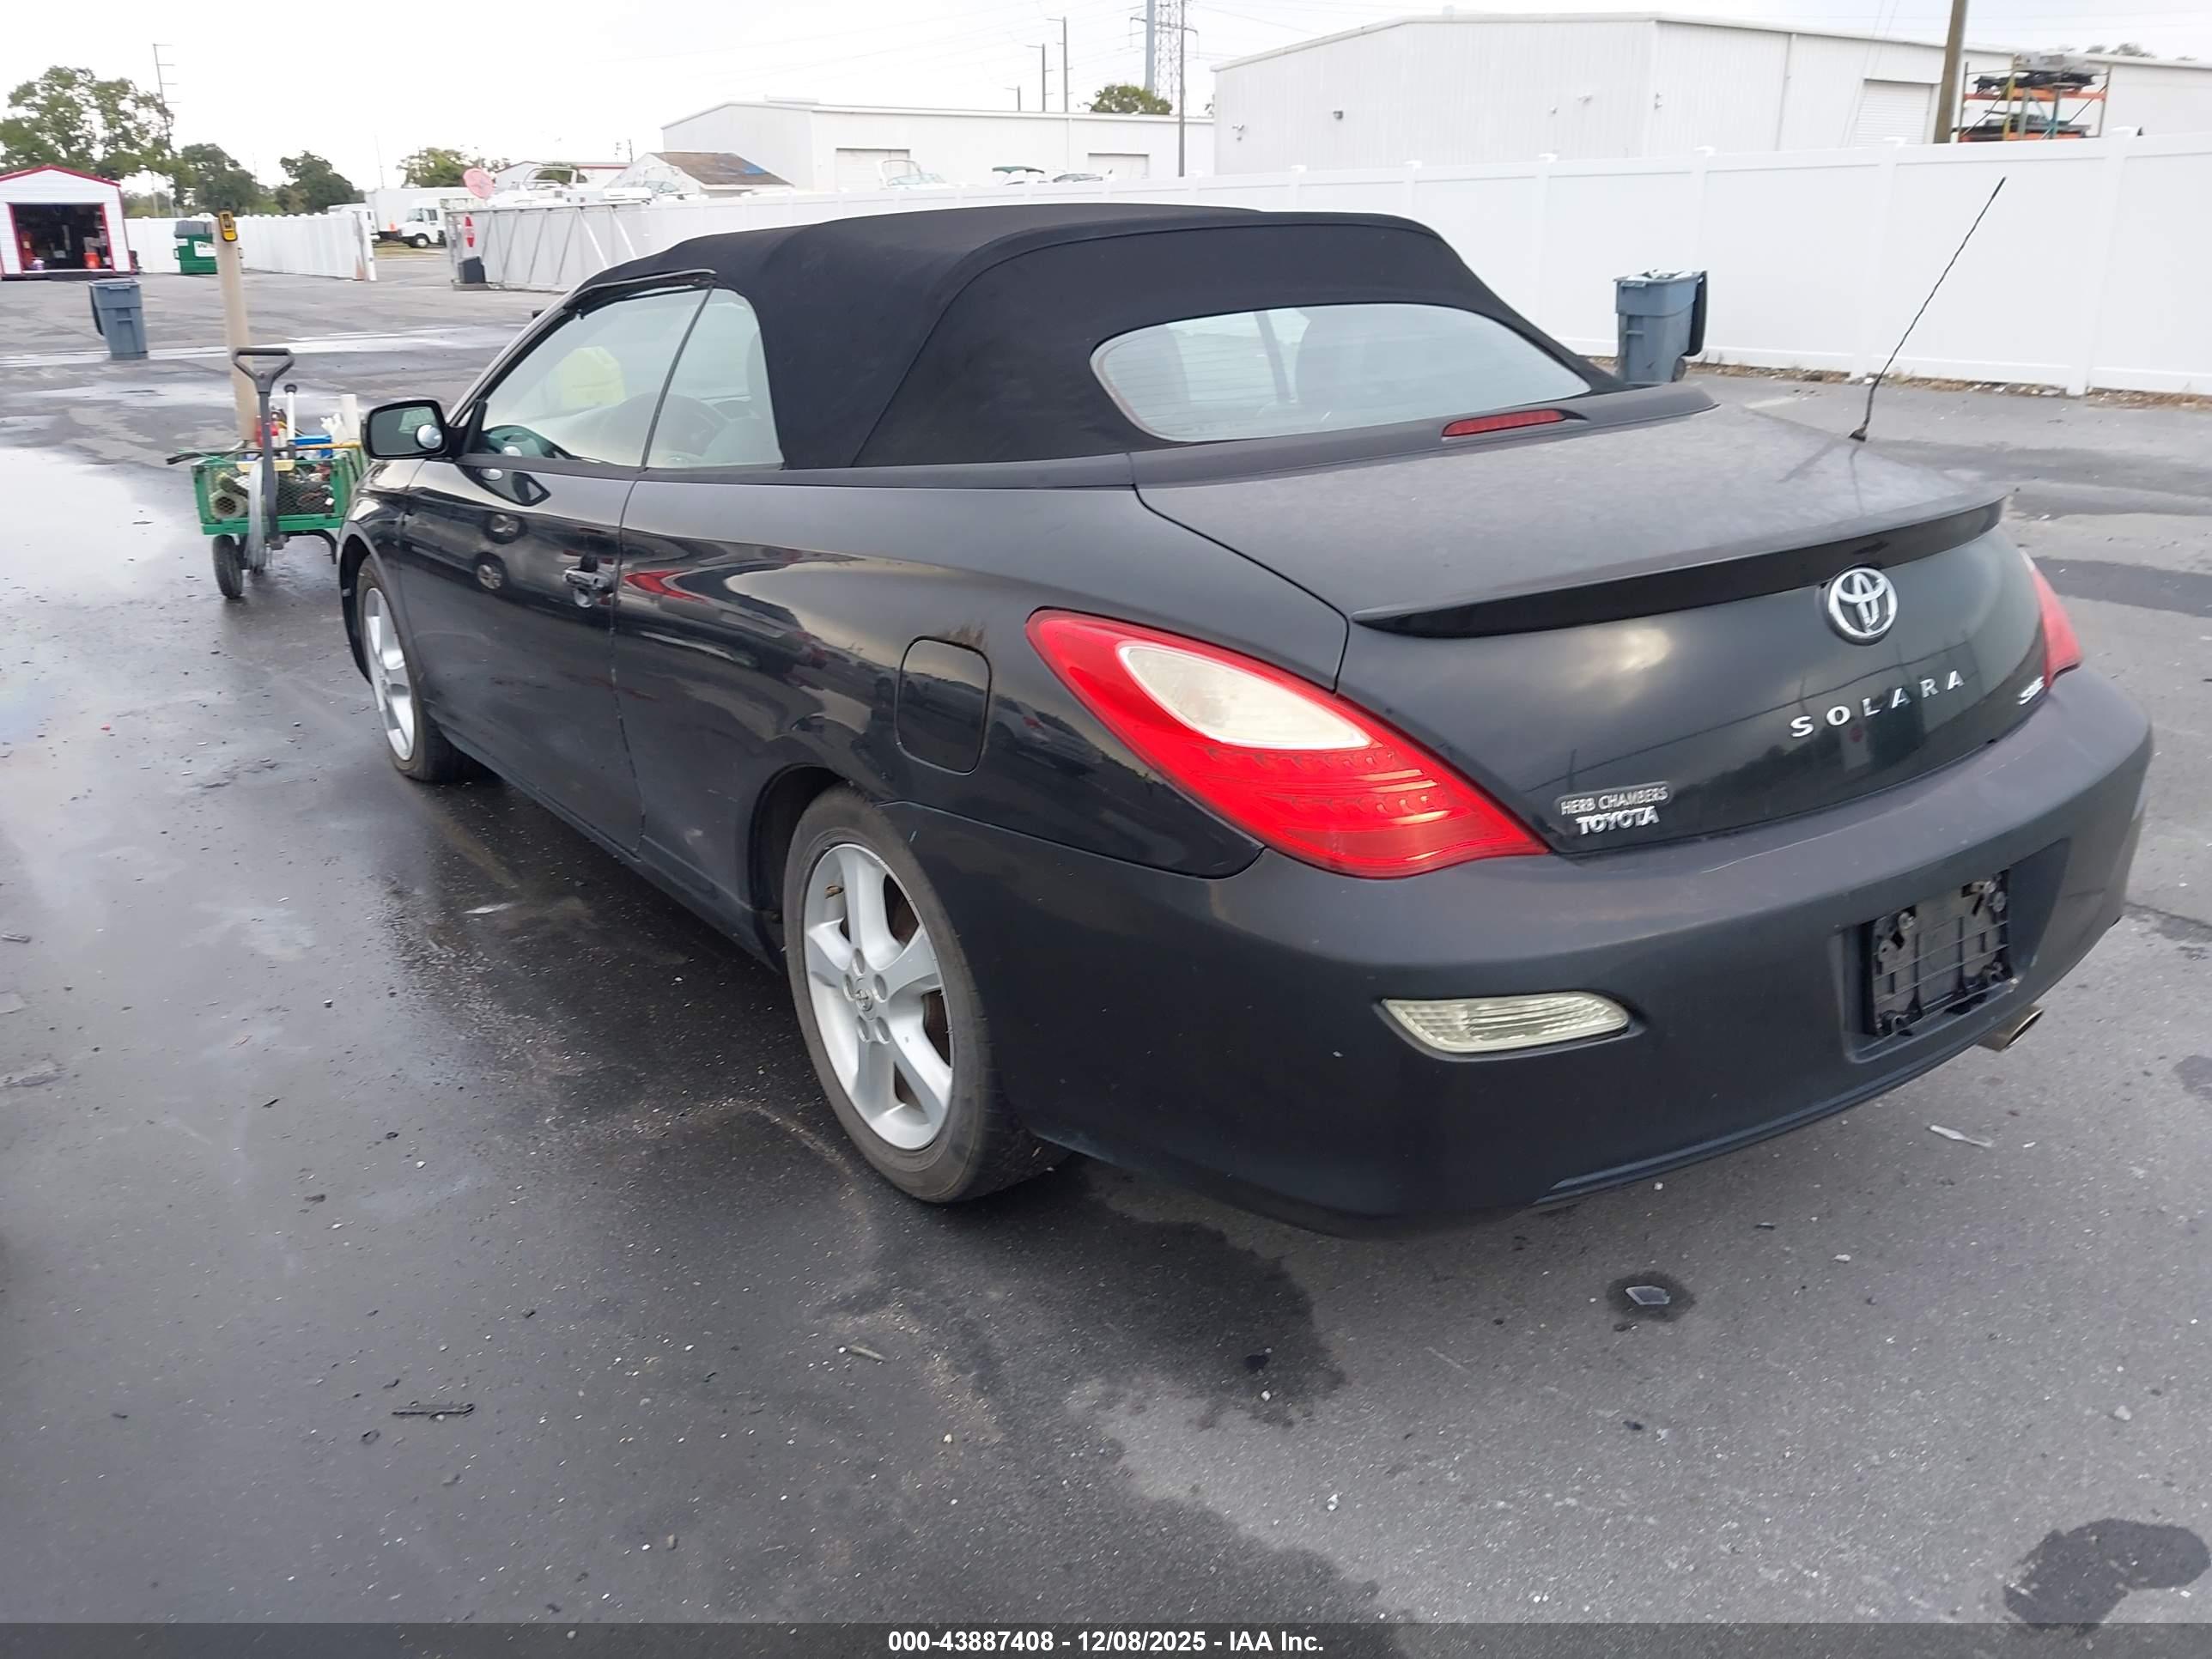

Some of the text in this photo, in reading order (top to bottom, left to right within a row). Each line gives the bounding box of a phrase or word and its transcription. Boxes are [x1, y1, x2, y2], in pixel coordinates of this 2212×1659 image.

[1790, 670, 1965, 738] SOLARA
[1561, 787, 1668, 815] HERB CHAMBERS
[1576, 805, 1660, 835] TOYOTA
